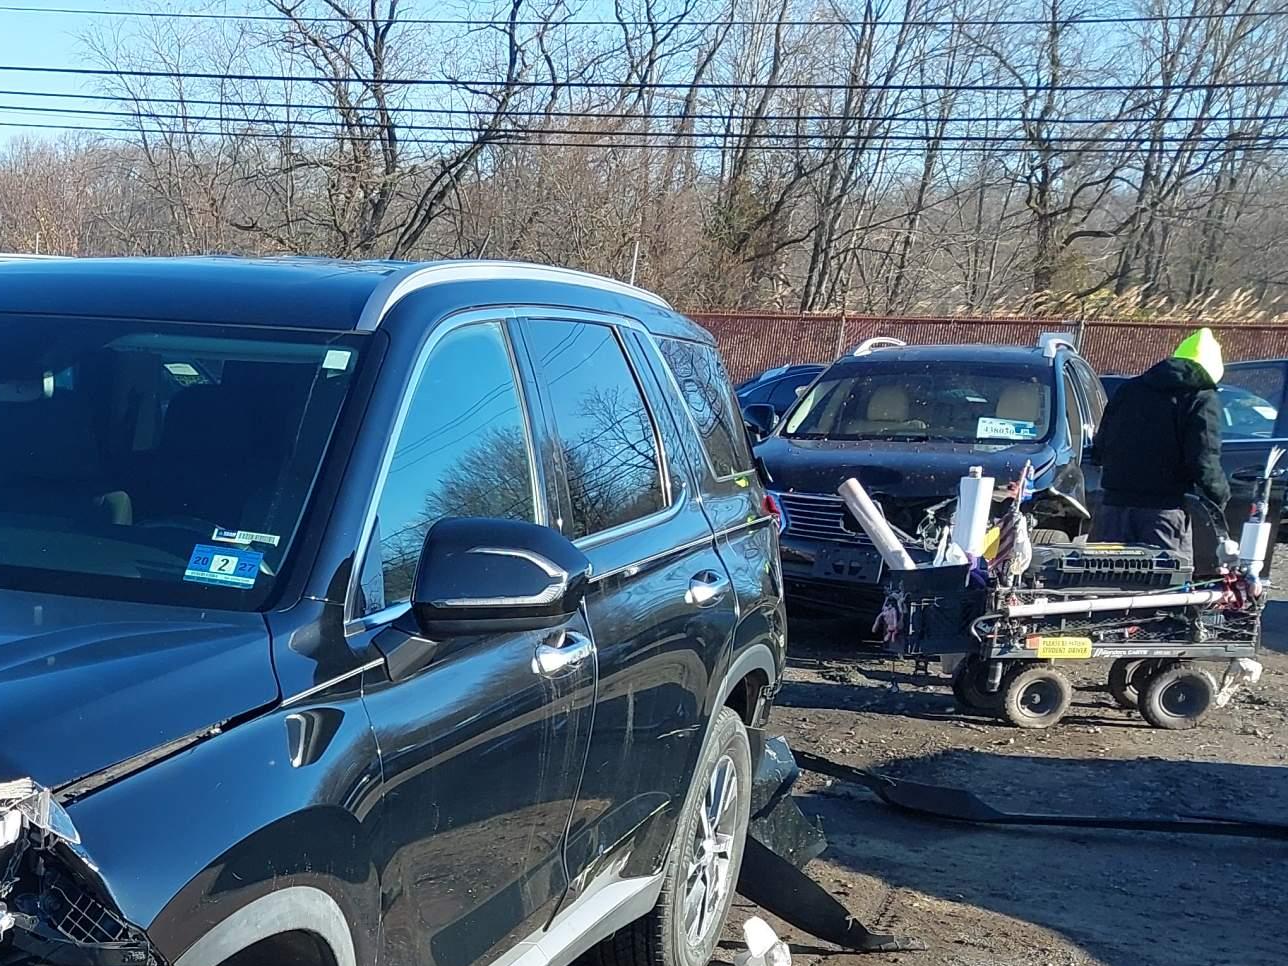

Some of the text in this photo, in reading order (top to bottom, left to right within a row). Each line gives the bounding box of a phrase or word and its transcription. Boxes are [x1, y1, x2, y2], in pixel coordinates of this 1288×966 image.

[193, 556, 256, 573] 20 2 27
